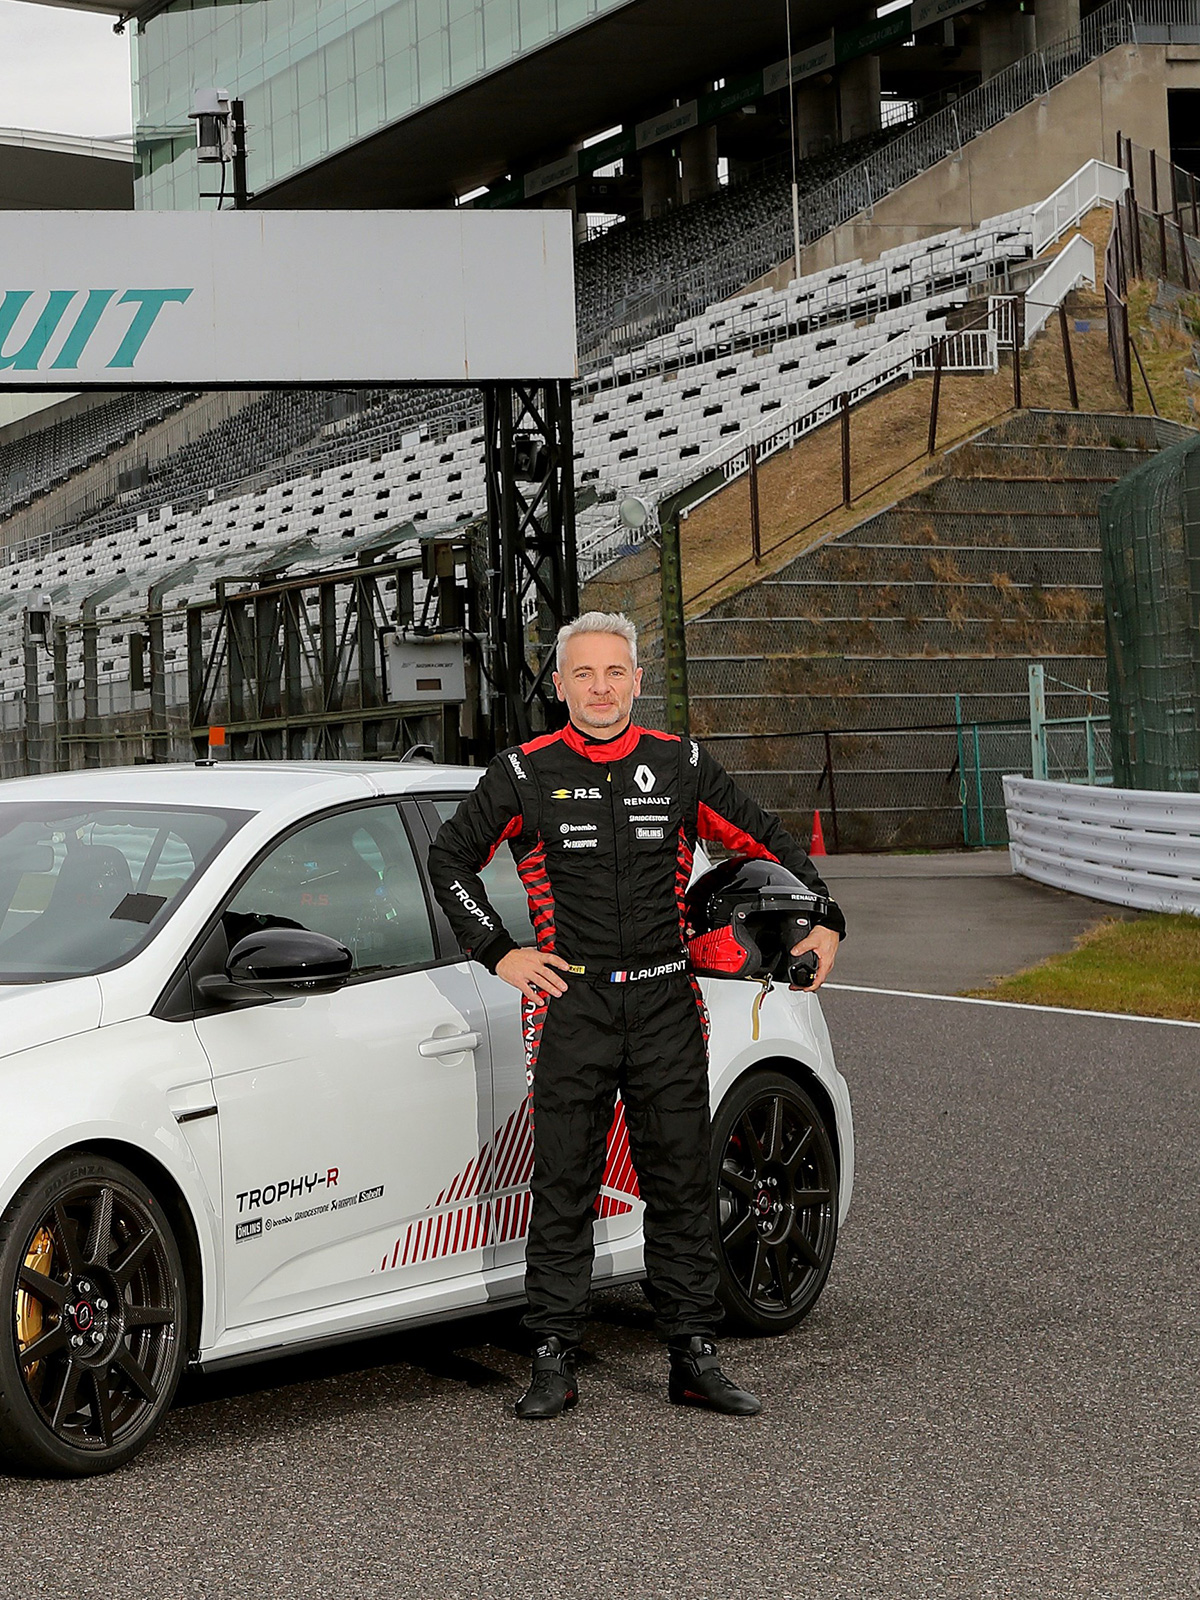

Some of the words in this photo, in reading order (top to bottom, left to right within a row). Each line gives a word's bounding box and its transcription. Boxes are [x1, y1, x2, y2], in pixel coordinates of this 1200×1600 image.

[507, 752, 528, 781] Sabelt
[573, 787, 603, 800] R.S.
[623, 796, 672, 806] RENAULT
[628, 814, 670, 822] BRIDGESTONE
[790, 894, 818, 902] RENAULT
[629, 960, 687, 981] LAURENT
[236, 1167, 339, 1213] TROPHY-R
[294, 1203, 330, 1221] BRIDGESTONE
